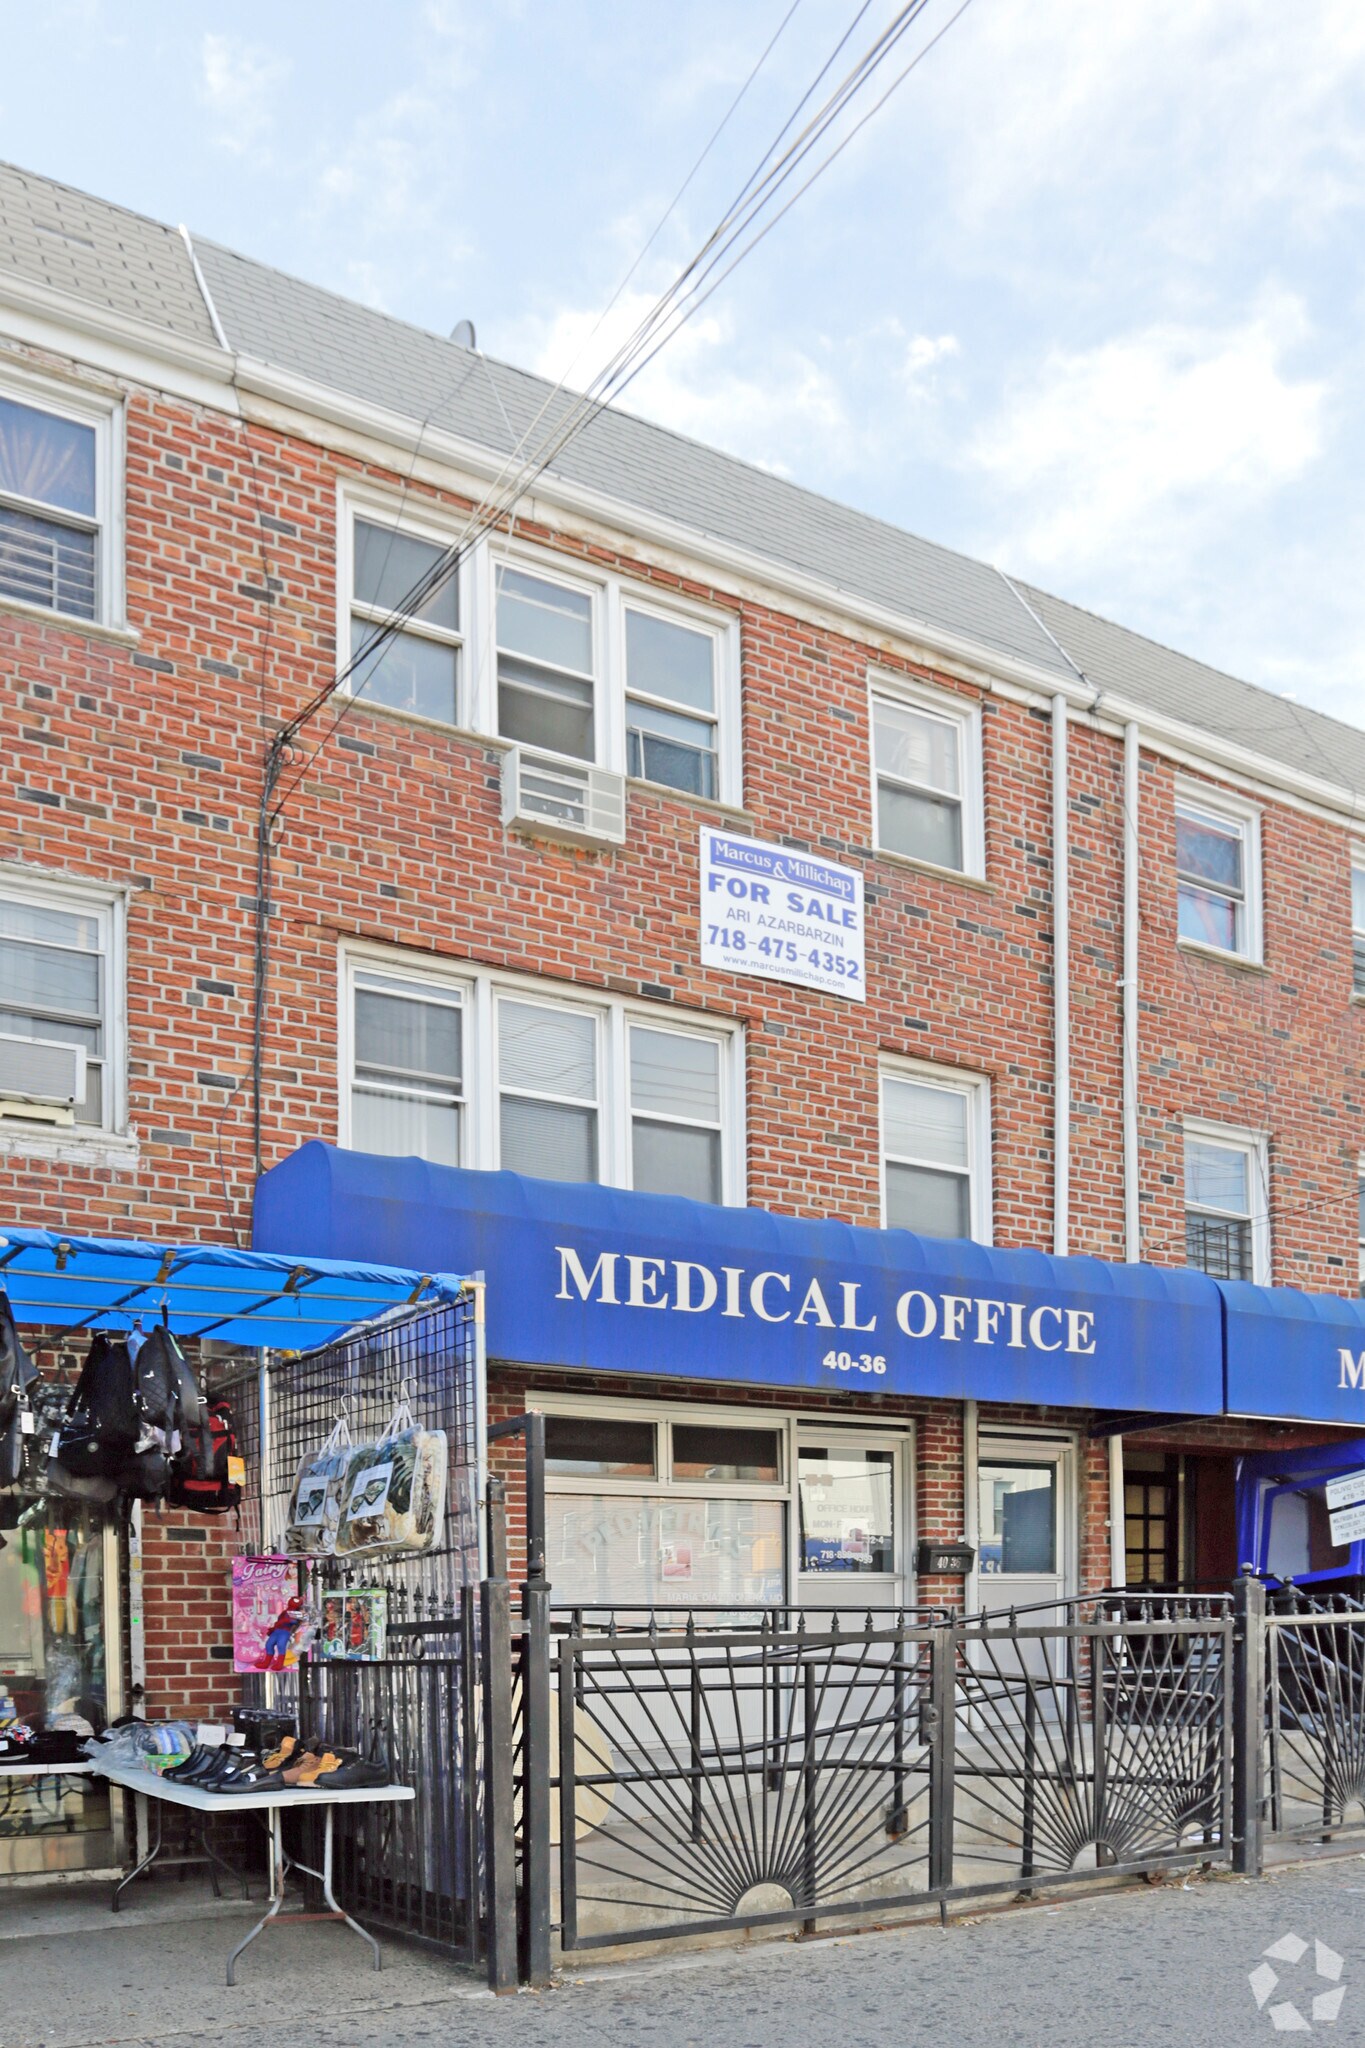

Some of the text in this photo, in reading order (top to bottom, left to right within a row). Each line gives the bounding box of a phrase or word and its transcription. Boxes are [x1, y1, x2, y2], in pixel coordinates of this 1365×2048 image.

[715, 840, 852, 897] Marcus & Millichap
[707, 871, 858, 930] FOR SALE
[726, 906, 845, 948] ARI AZARBARZIN
[706, 924, 860, 981] 718-475-4352
[722, 954, 846, 989] www.marcusmillichap.com
[553, 1245, 1098, 1356] MEDICAL OFFICE
[822, 1349, 888, 1374] 40-36
[816, 1504, 848, 1513] OFFICE
[822, 1536, 839, 1544] SAT
[241, 1562, 288, 1580] Fairy
